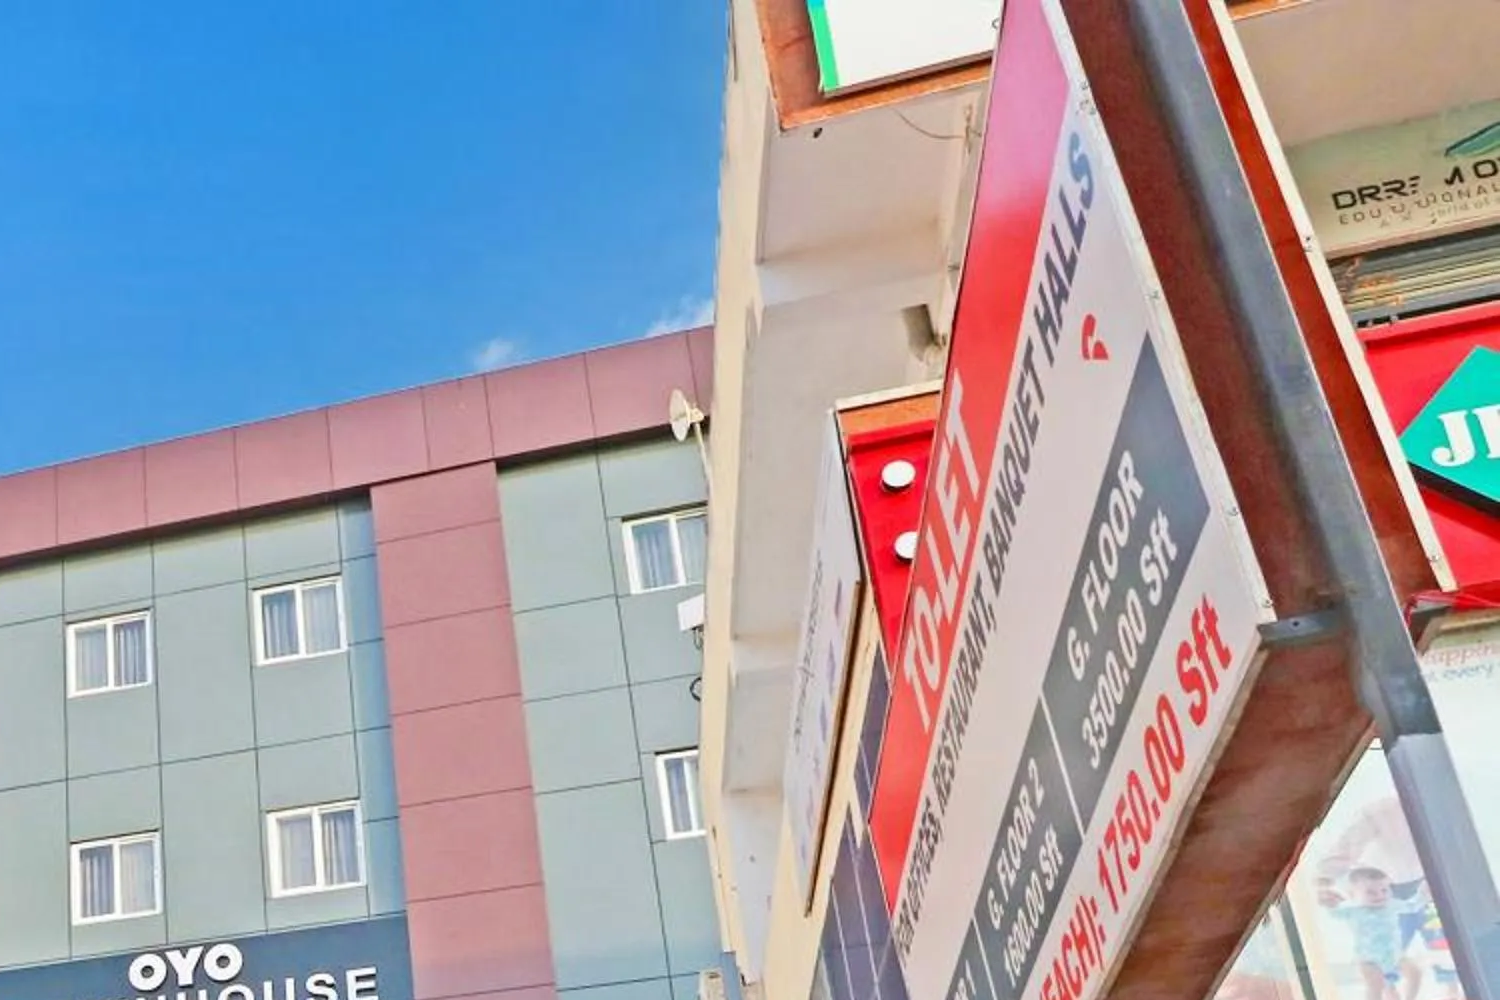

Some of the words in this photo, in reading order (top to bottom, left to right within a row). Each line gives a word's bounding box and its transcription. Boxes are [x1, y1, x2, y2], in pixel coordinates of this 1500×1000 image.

[904, 368, 980, 733] TO-LET
[931, 571, 998, 816] RESTAURANT,
[982, 337, 1046, 587] BANQUET
[1034, 132, 1095, 369] HALLS
[1067, 626, 1090, 681] G.
[1081, 450, 1144, 635] FLOOR
[1082, 588, 1148, 769] 3500.00
[1139, 506, 1178, 606] Sft
[987, 888, 1005, 930] G.
[997, 783, 1037, 901] FLOOR
[1028, 757, 1045, 809] 2
[1097, 693, 1186, 914] 1750.00
[1176, 593, 1232, 727] Sft
[128, 943, 244, 991] OYO
[965, 959, 977, 996] 1
[1003, 870, 1046, 988] 1600.00
[1038, 821, 1064, 893] Sft
